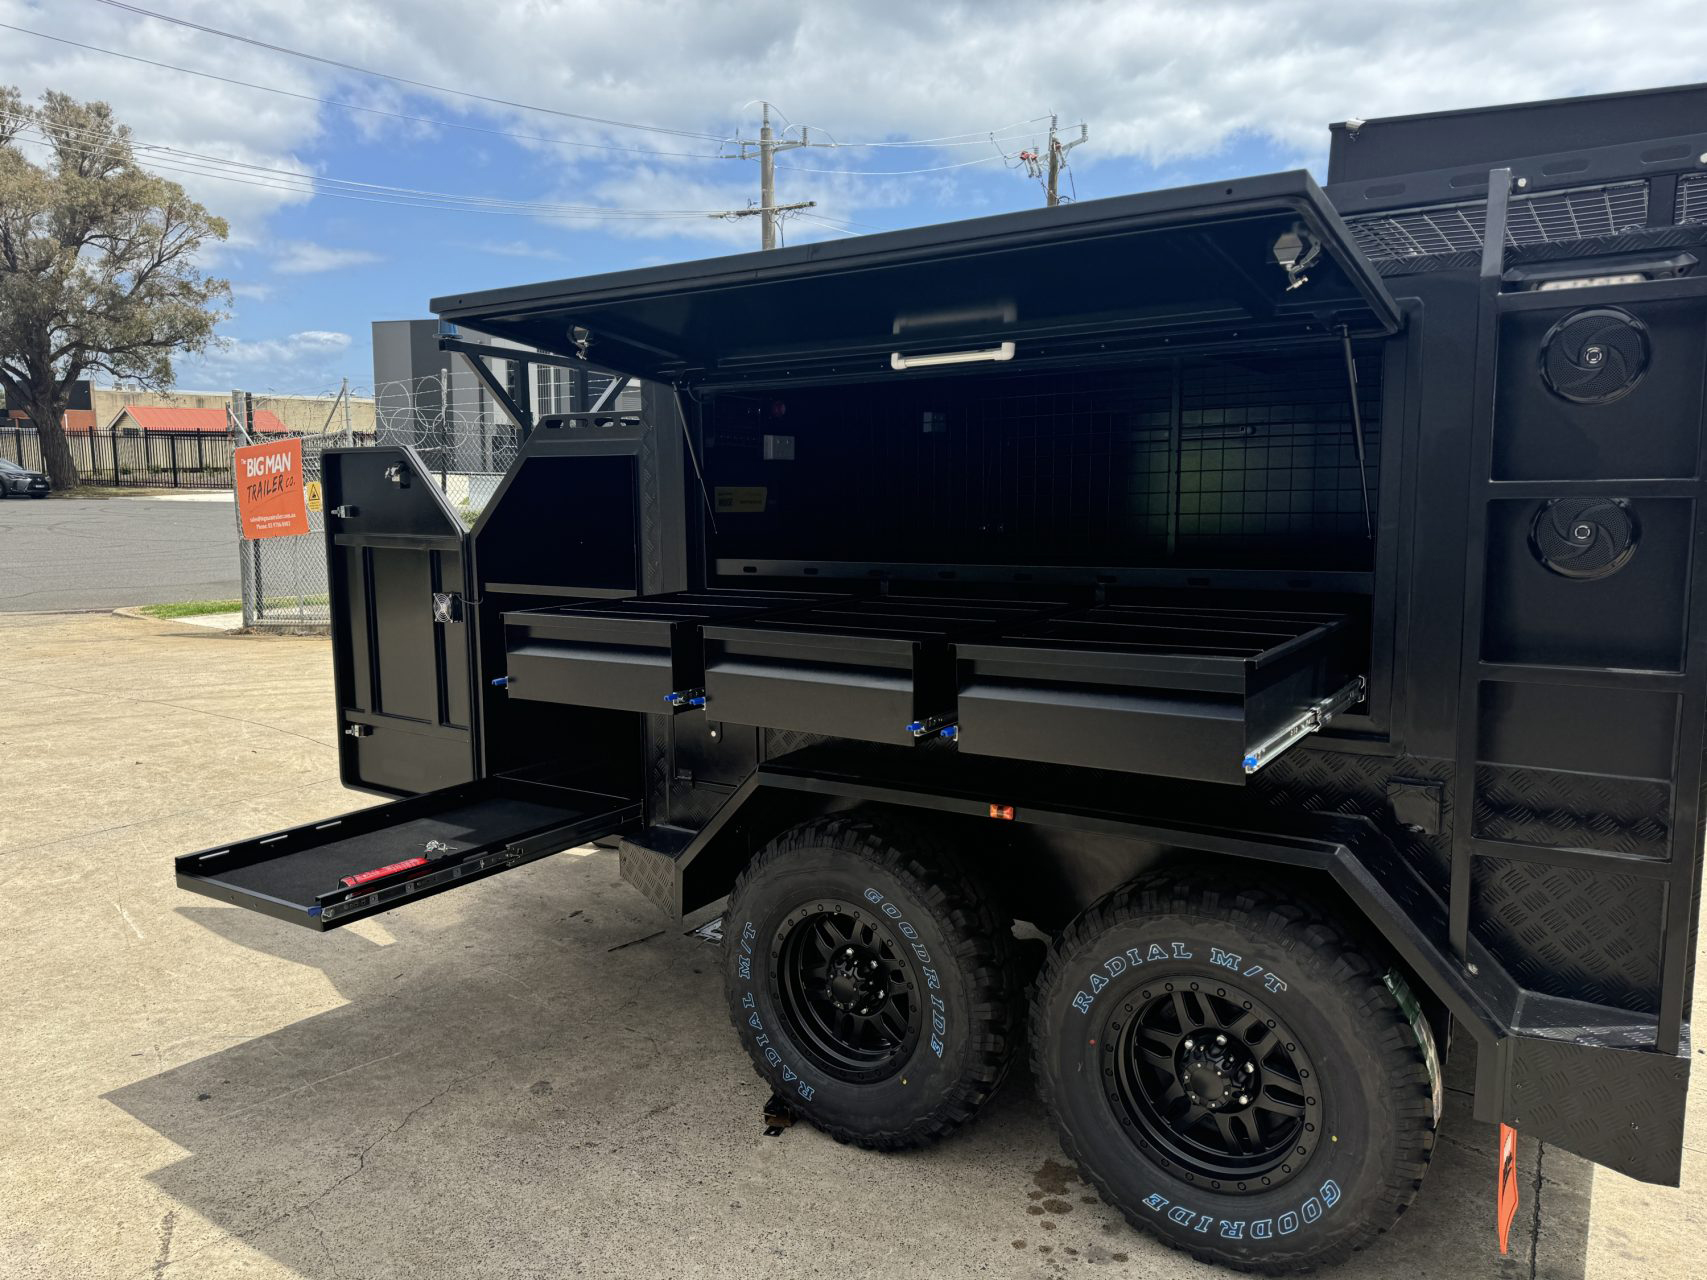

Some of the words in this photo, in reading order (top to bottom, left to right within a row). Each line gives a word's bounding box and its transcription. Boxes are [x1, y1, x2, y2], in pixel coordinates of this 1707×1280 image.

[246, 456, 265, 478] BIG
[265, 451, 292, 475] MAN
[246, 473, 284, 504] TRAILER
[738, 922, 757, 980] M/T
[864, 888, 946, 1058] GOODRIDE
[1072, 942, 1192, 1014] RADIAL
[1210, 948, 1288, 994] M/T
[742, 992, 815, 1101] RADIAL
[1143, 1179, 1341, 1239] GOODRIDE
